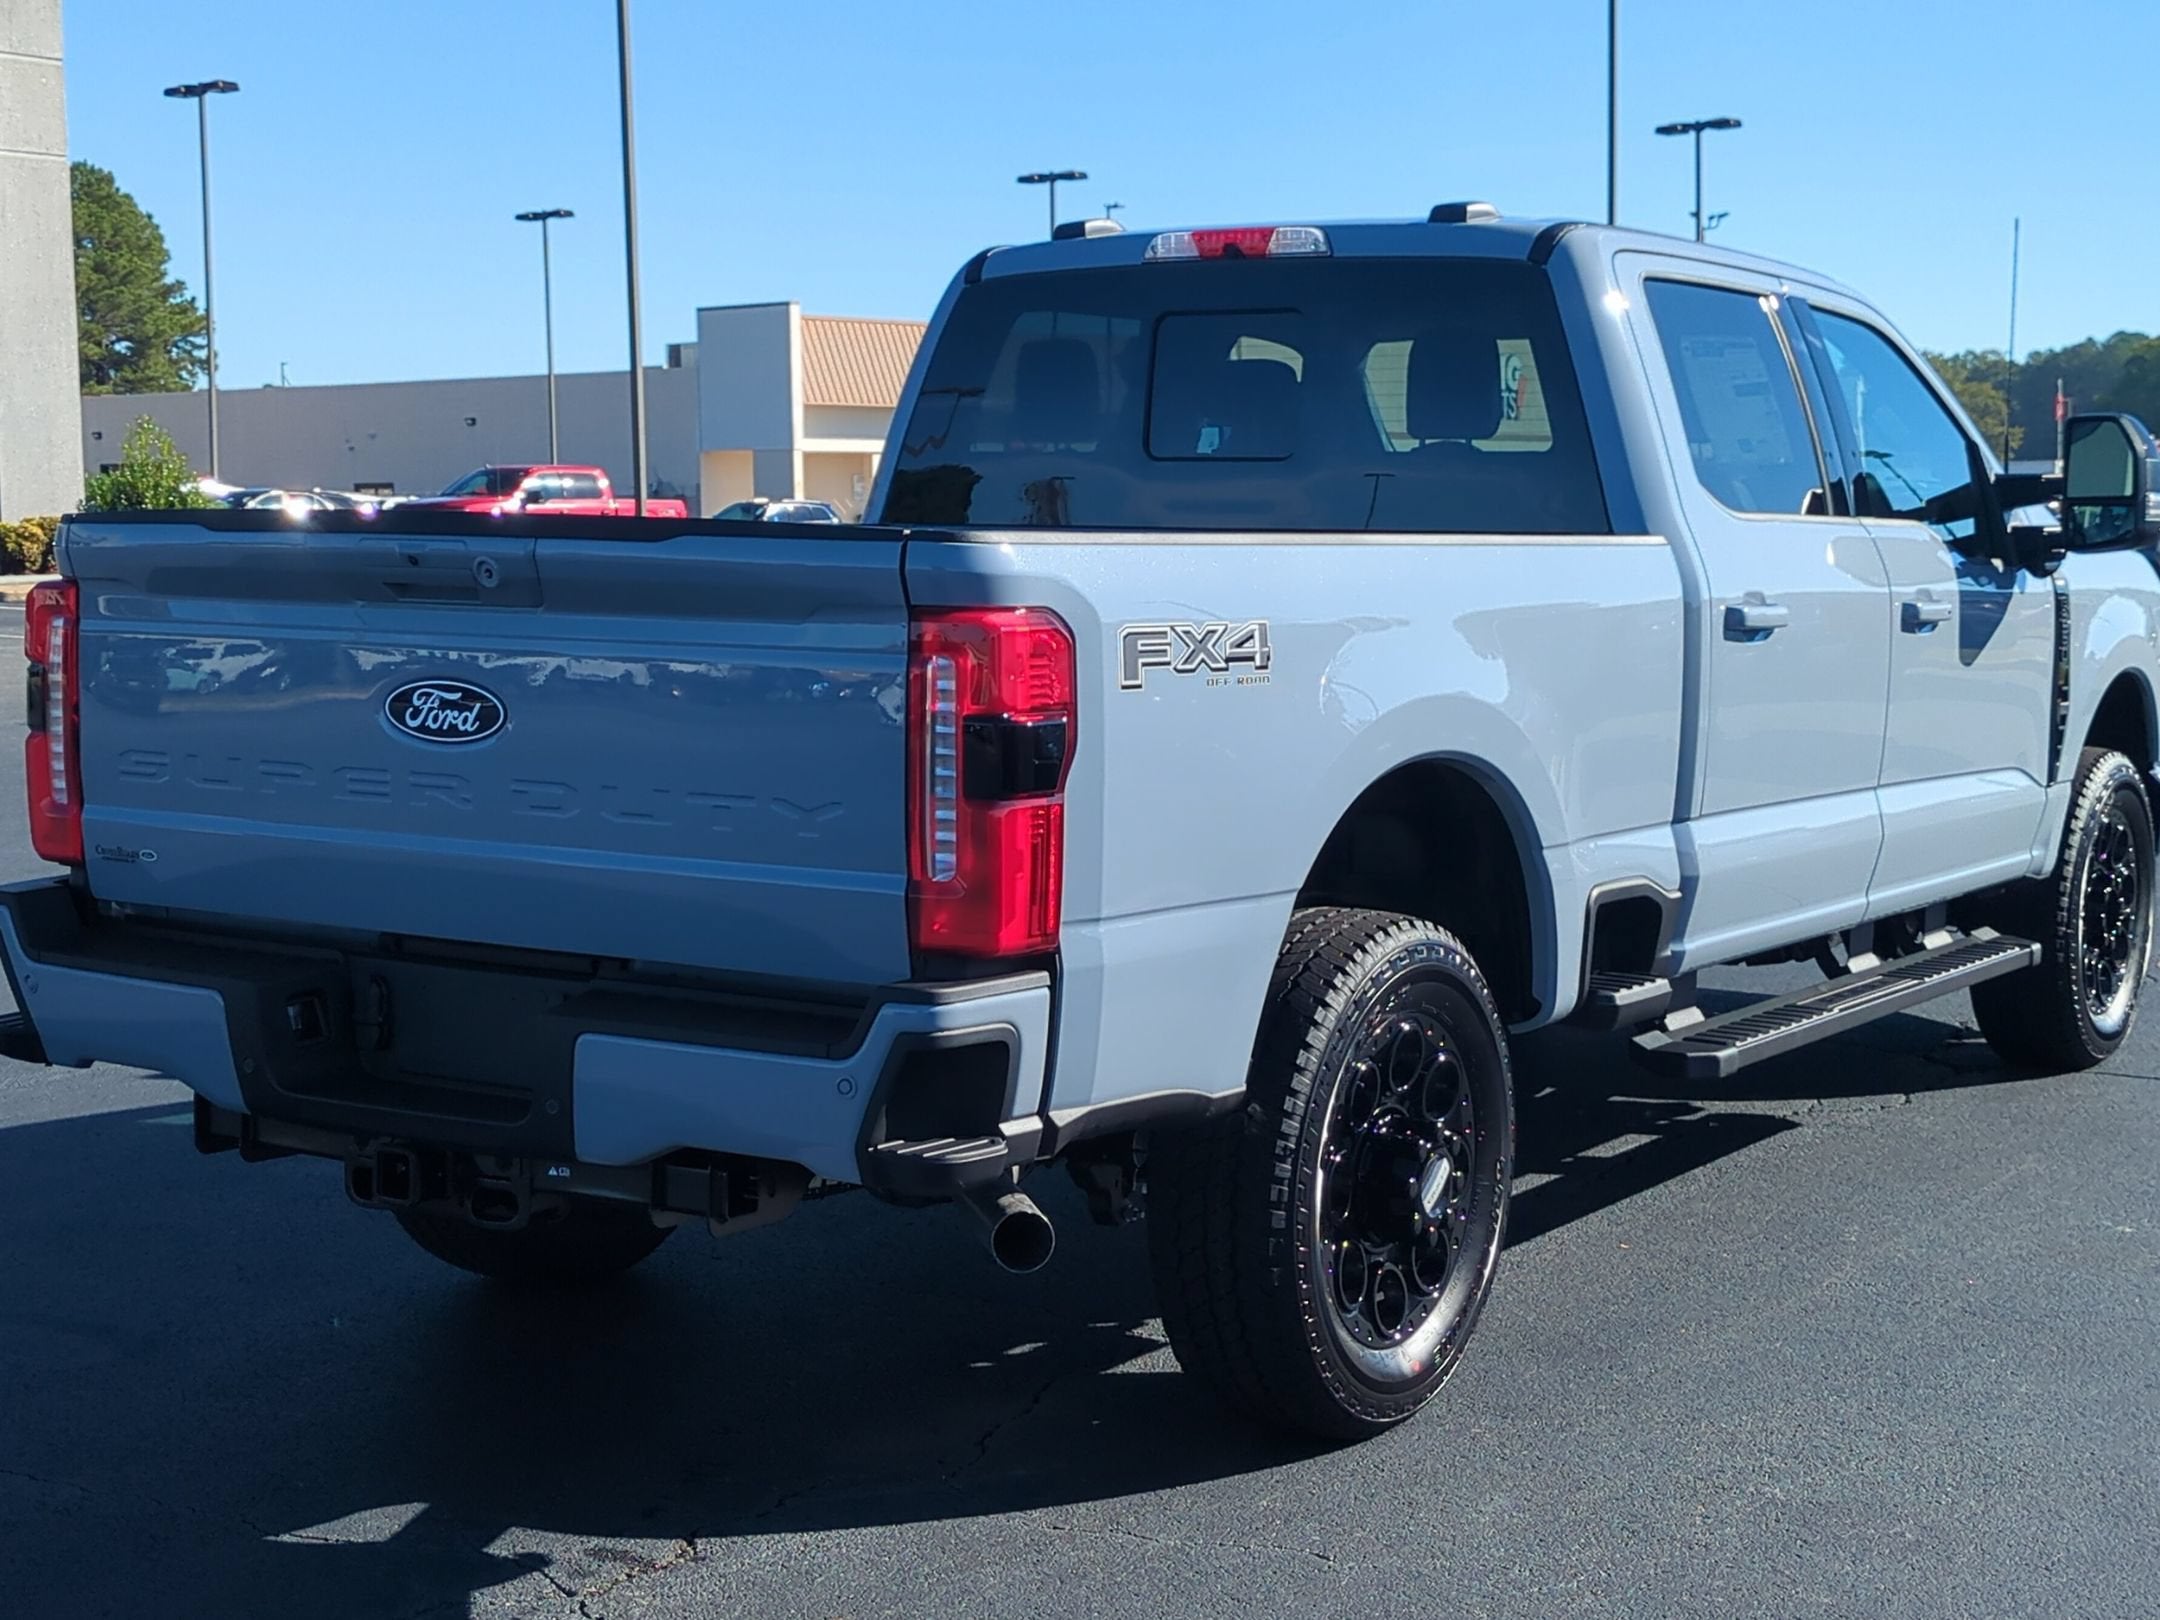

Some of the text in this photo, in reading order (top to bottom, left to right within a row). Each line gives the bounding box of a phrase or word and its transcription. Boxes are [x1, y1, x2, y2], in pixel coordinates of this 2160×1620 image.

[1500, 353, 1521, 391] IG
[1118, 620, 1272, 692] FX4
[1206, 674, 1271, 688] OFF ROAD
[405, 688, 480, 732] Ford
[118, 748, 844, 837] SUPER DUTY
